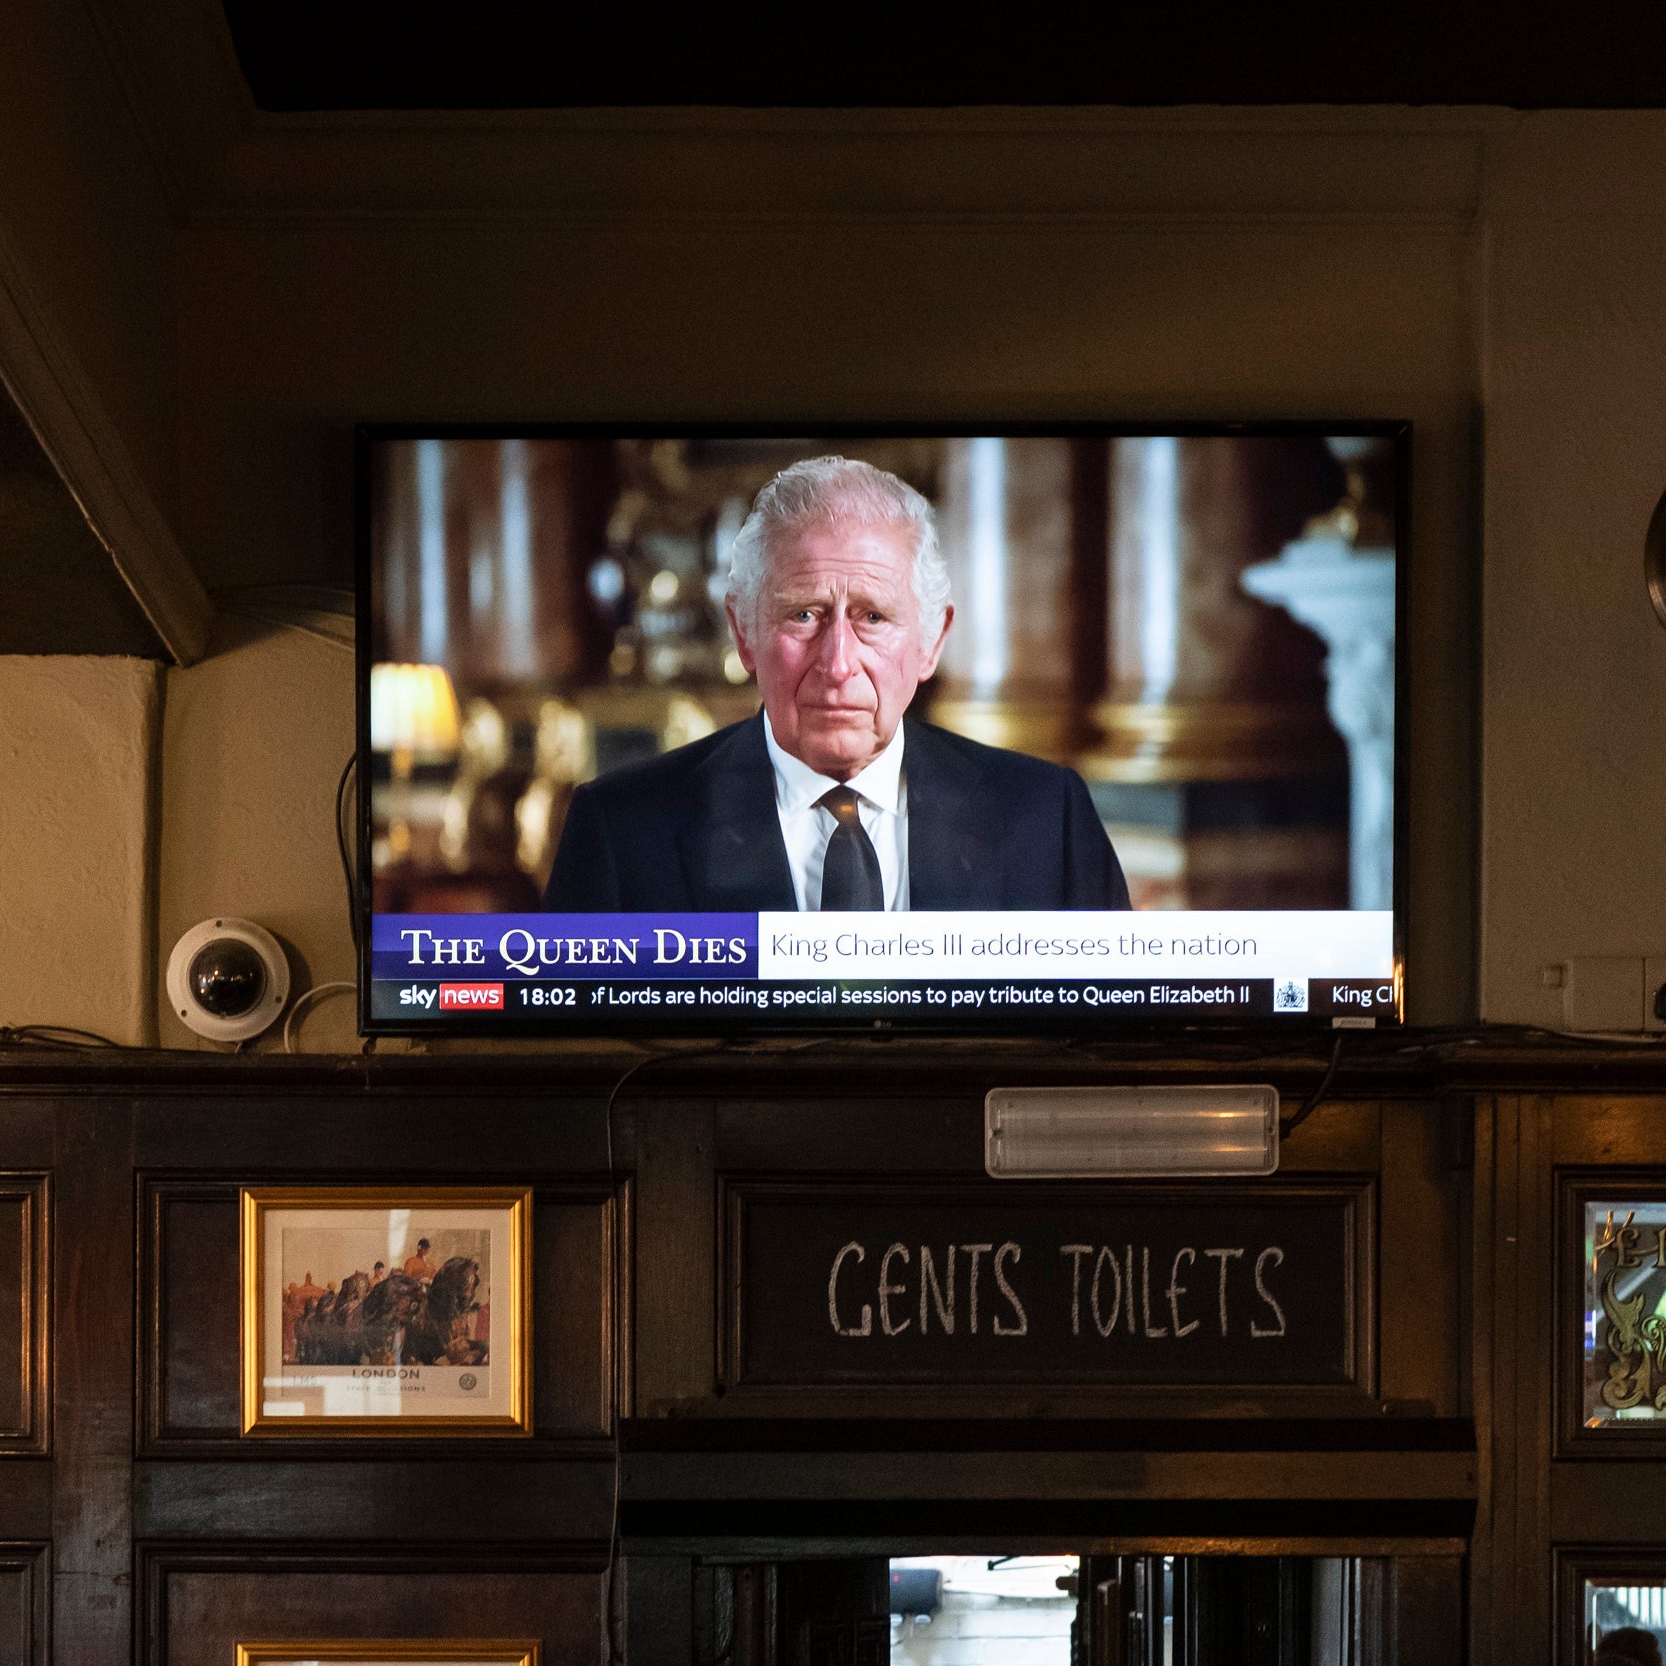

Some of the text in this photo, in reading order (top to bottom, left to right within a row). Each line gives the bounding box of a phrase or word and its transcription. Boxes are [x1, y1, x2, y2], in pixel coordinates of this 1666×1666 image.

[400, 928, 747, 976] THE QUEEN DIES
[772, 933, 1257, 962] King Charles III addresses the nation
[399, 984, 500, 1009] sky news
[520, 987, 577, 1005] 18:02
[609, 986, 661, 1004] Lords
[665, 989, 696, 1004] are
[700, 986, 769, 1009] holding
[772, 986, 836, 1009] special
[841, 986, 922, 1004] sessions
[926, 987, 947, 1004] to
[951, 989, 985, 1008] pay
[989, 986, 1054, 1004] tribute
[1058, 987, 1079, 1004] to
[1083, 986, 1145, 1006] Queen
[1150, 985, 1235, 1004] Elizabeth
[1240, 986, 1250, 1004] II
[1332, 985, 1372, 1007] King
[828, 1240, 1286, 1339] GENTS TOILETS
[352, 1368, 420, 1380] LONDON
